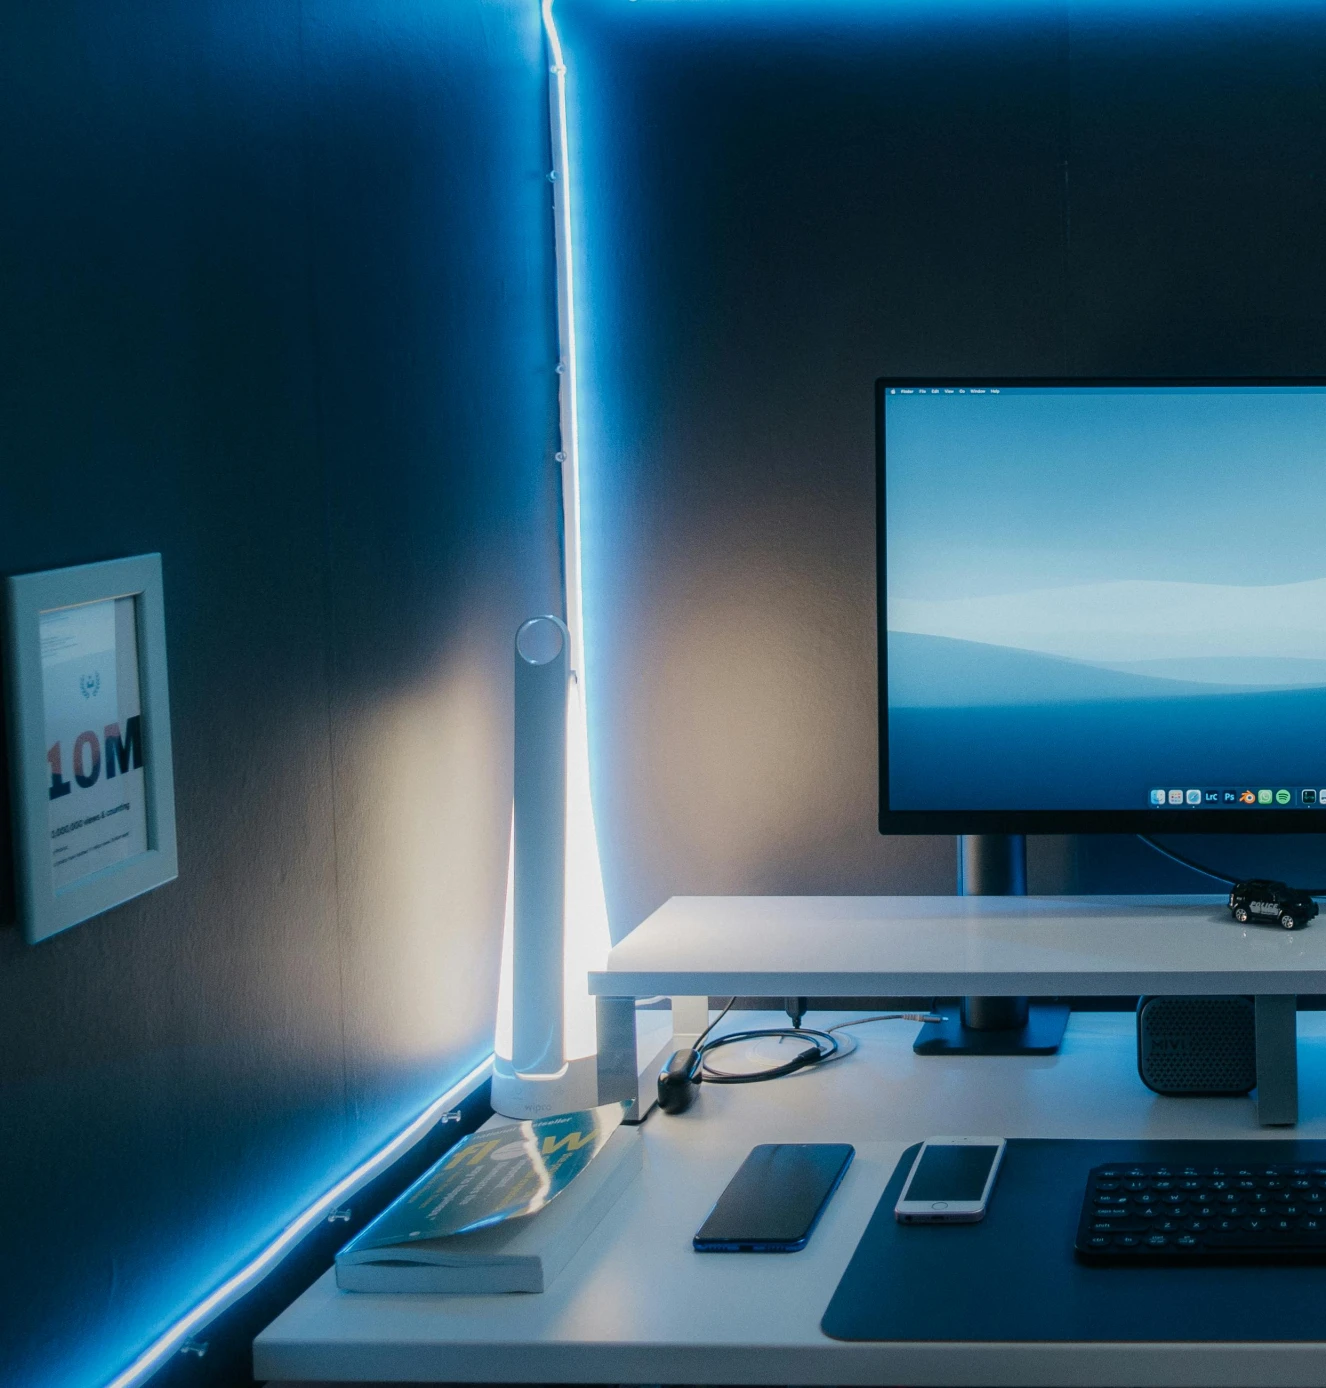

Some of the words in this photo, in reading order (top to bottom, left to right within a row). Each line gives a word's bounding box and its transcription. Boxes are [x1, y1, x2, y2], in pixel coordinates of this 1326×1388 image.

[46, 715, 143, 800] 10M
[1205, 793, 1218, 801] LrC
[1225, 793, 1235, 801] Ps
[84, 814, 100, 825] views
[107, 802, 130, 813] counting
[524, 1104, 552, 1113] wipro
